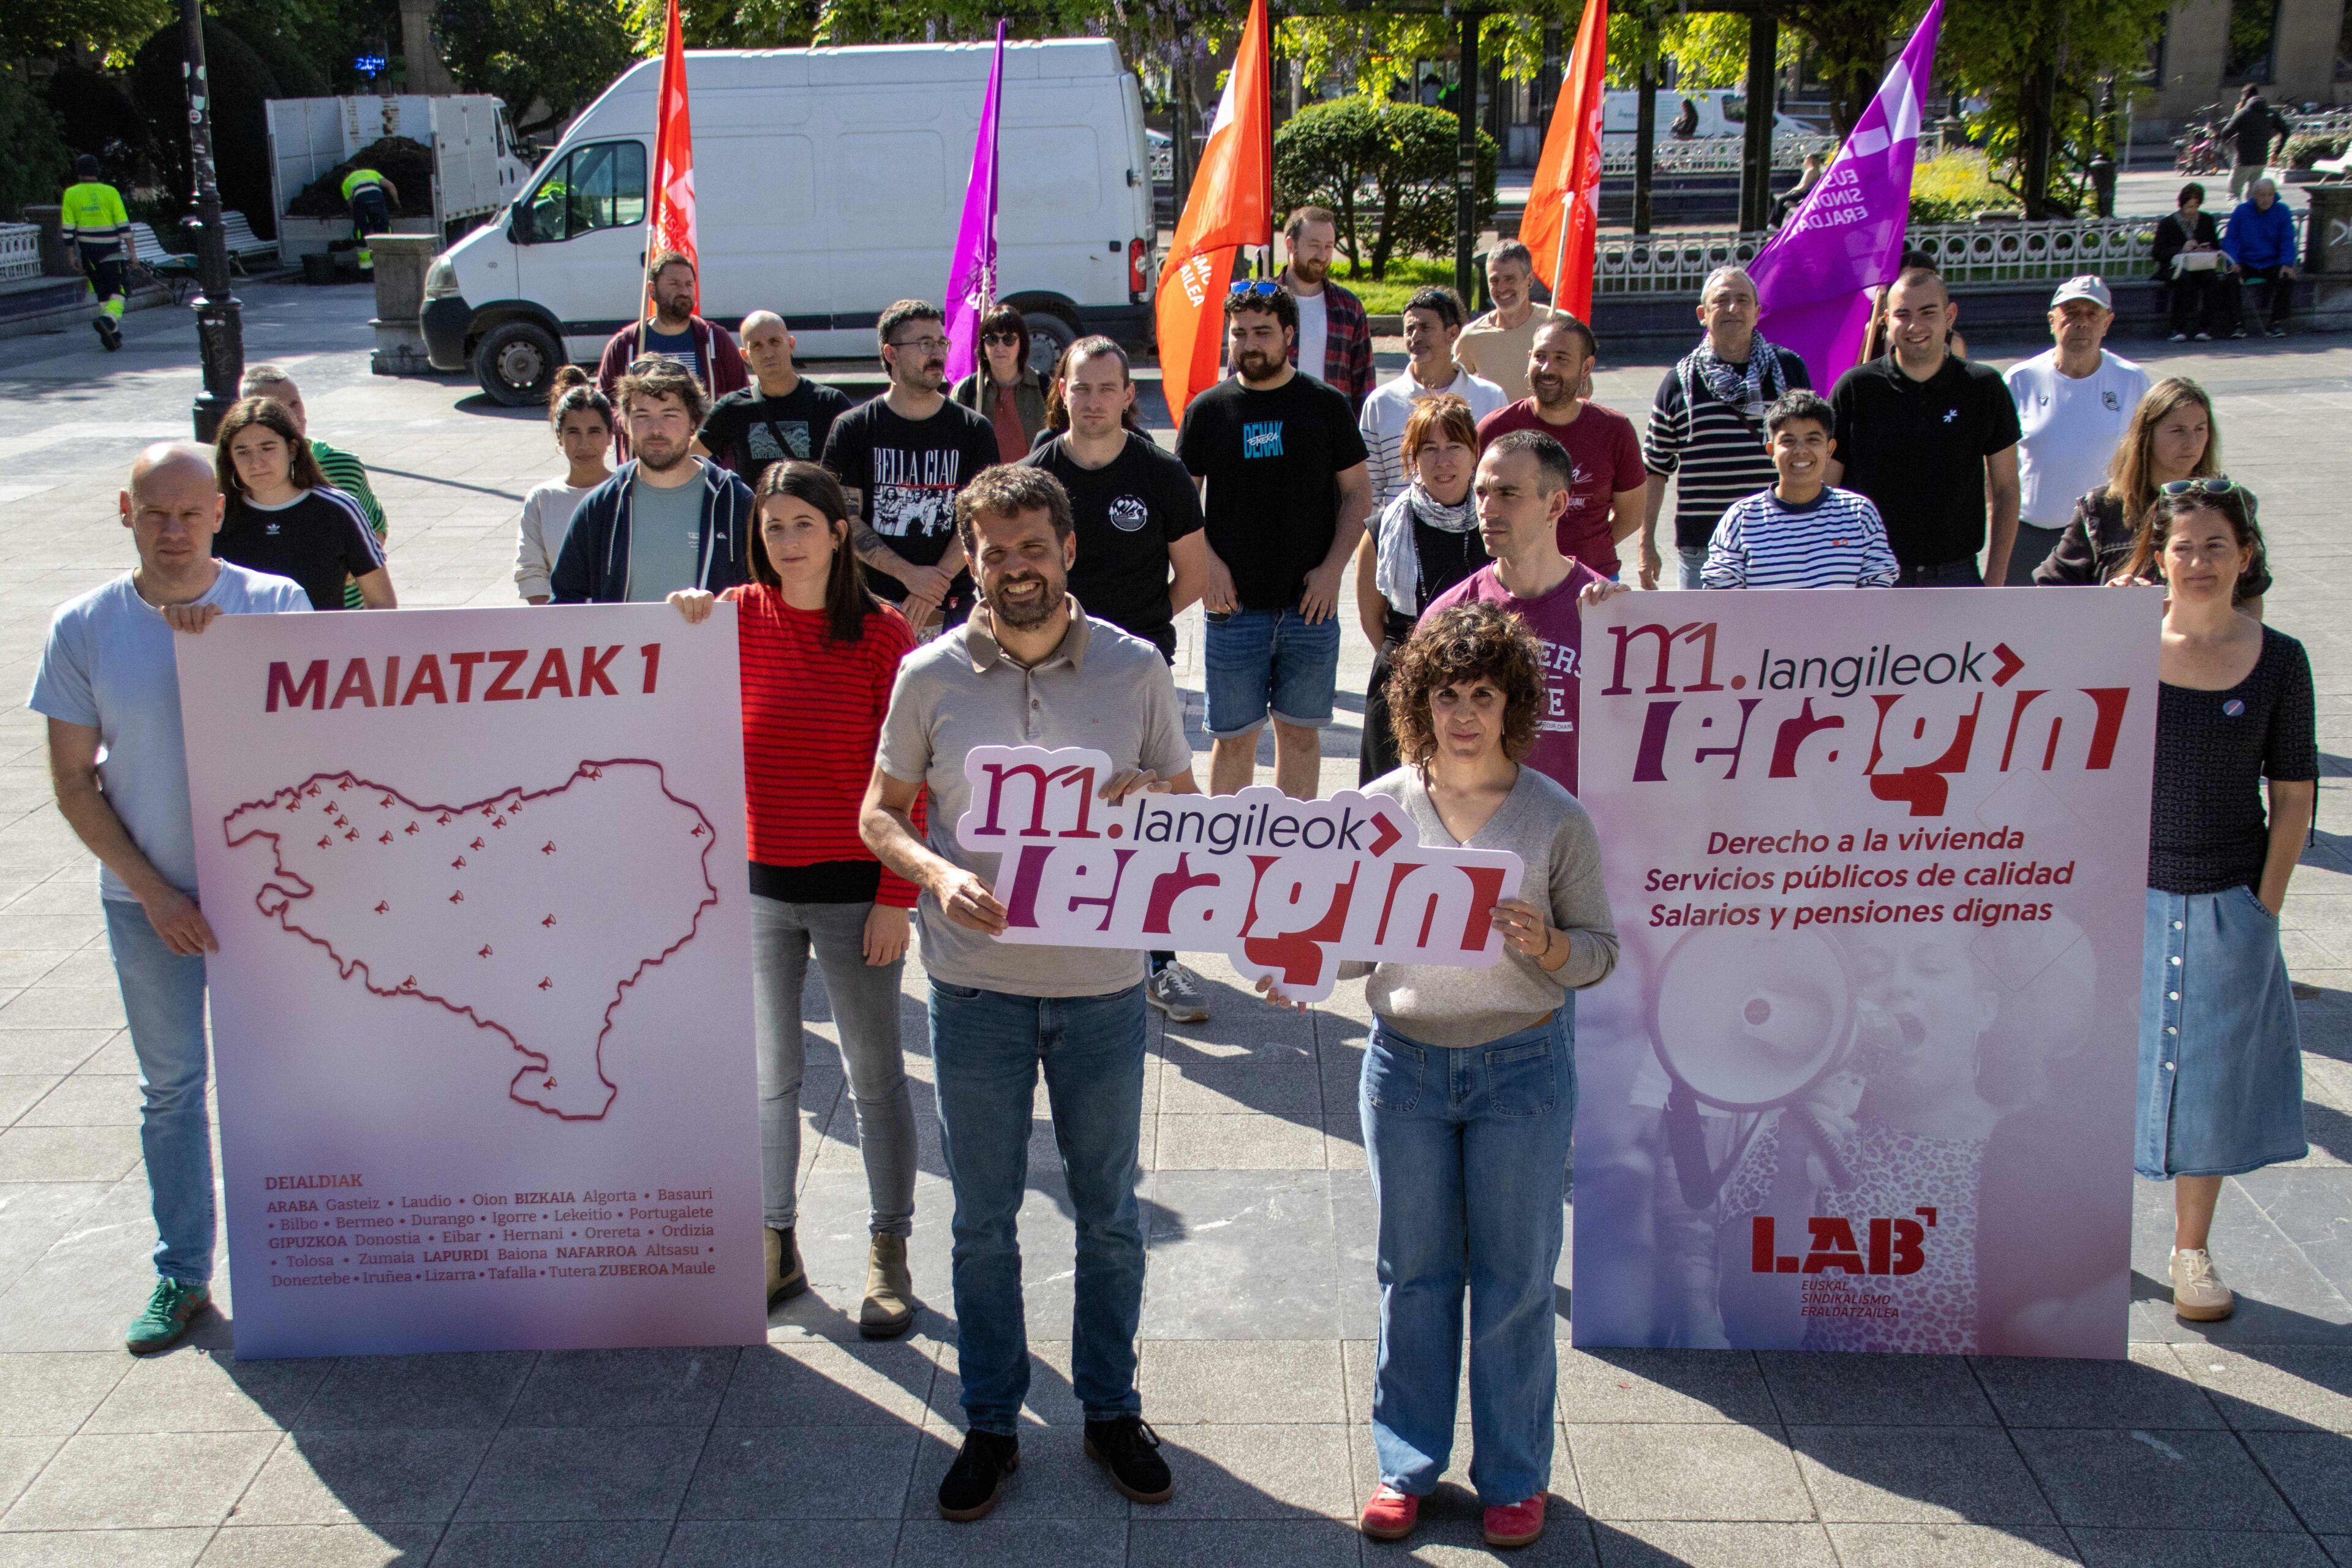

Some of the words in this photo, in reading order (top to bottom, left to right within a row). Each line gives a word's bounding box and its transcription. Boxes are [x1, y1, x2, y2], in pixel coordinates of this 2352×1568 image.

[1244, 423, 1284, 458] DENAK
[873, 447, 918, 486] BELLA
[924, 449, 959, 486] CIAO
[265, 644, 625, 713] MAIATZAK
[640, 643, 661, 694] 1
[1758, 641, 1988, 697] langileok
[1133, 799, 1366, 855] langileok
[1708, 829, 1828, 857] Derecho
[1838, 835, 1853, 852] a
[1863, 827, 1891, 851] la
[1898, 826, 2024, 850] vivienda
[1645, 865, 1774, 893] Servicios
[1782, 863, 1907, 895] públicos
[1917, 863, 1953, 887] de
[1963, 861, 2075, 886] calidad
[1648, 900, 1760, 928] Salarios
[1769, 907, 1787, 930] y
[1792, 900, 1943, 930] pensiones
[1952, 899, 2052, 927] dignas
[265, 1174, 363, 1189] DEIALDIAK
[267, 1200, 318, 1212] ARABA
[326, 1197, 380, 1210] Gasteiz
[402, 1194, 451, 1208] Laudio
[473, 1193, 508, 1205] Oion
[515, 1192, 575, 1204] BIZKAIA
[583, 1190, 636, 1205] Algorta
[658, 1187, 712, 1200] Basauri
[281, 1217, 318, 1230] Bilbo
[336, 1216, 394, 1228] Bermeo
[412, 1213, 475, 1227] Durango
[492, 1211, 537, 1226] Igorre
[555, 1208, 612, 1221] Lekeitio
[629, 1205, 714, 1221] Portugalete
[270, 1235, 347, 1248] GIPUZKOA
[355, 1232, 420, 1246] Donostia
[443, 1231, 481, 1242] Eibar
[503, 1227, 563, 1240] Hernani
[586, 1226, 640, 1238] Orereta
[662, 1224, 714, 1237] Ordizia
[1752, 1216, 1924, 1275] LAB
[287, 1254, 334, 1267] Tolosa
[359, 1251, 415, 1265] Zumaia
[424, 1250, 489, 1262] LAPURDI
[498, 1247, 547, 1259] Baiona
[557, 1246, 637, 1258] NAFARROA
[646, 1244, 699, 1256] Altsasu
[272, 1272, 350, 1287] Doneztebe
[363, 1270, 412, 1283] Iruñea
[425, 1266, 476, 1281] Lizarra
[489, 1266, 537, 1279] Tafalla
[549, 1265, 596, 1277] Tutera
[600, 1264, 669, 1276] ZUBEROA
[672, 1262, 715, 1275] Maule
[1801, 1280, 1849, 1291] EUSKAL
[1801, 1294, 1891, 1305] SINDIKALISMO
[1801, 1306, 1898, 1318] ERALDATZAILEA
